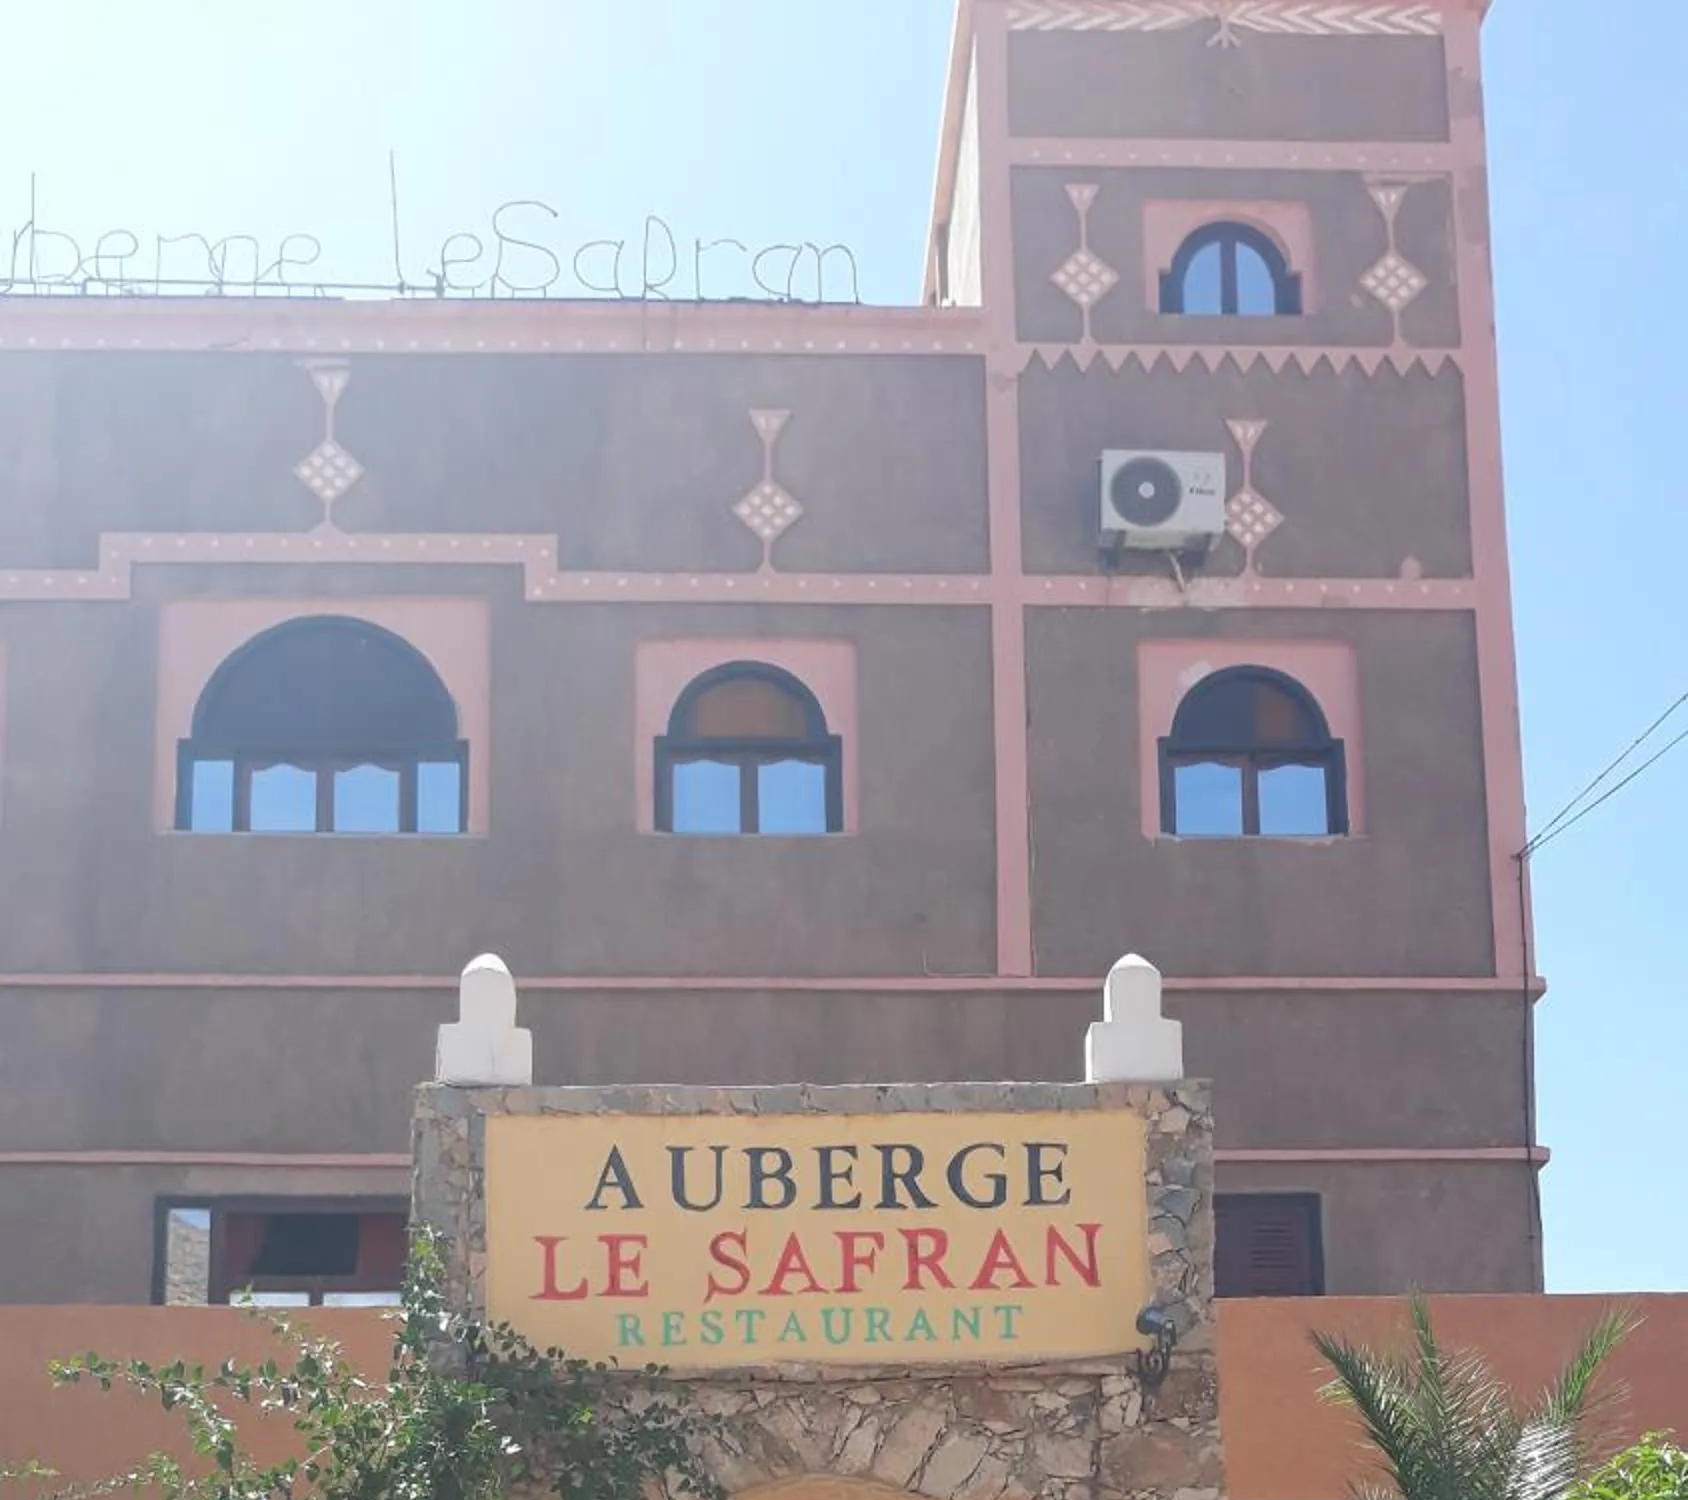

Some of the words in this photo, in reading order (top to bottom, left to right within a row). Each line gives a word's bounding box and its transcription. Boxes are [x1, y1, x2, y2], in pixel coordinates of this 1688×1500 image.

[584, 1141, 1073, 1212] AUBERGE
[528, 1233, 650, 1300] LE
[703, 1223, 1104, 1302] SAFRAN
[615, 1303, 1025, 1347] RESTAURANT
